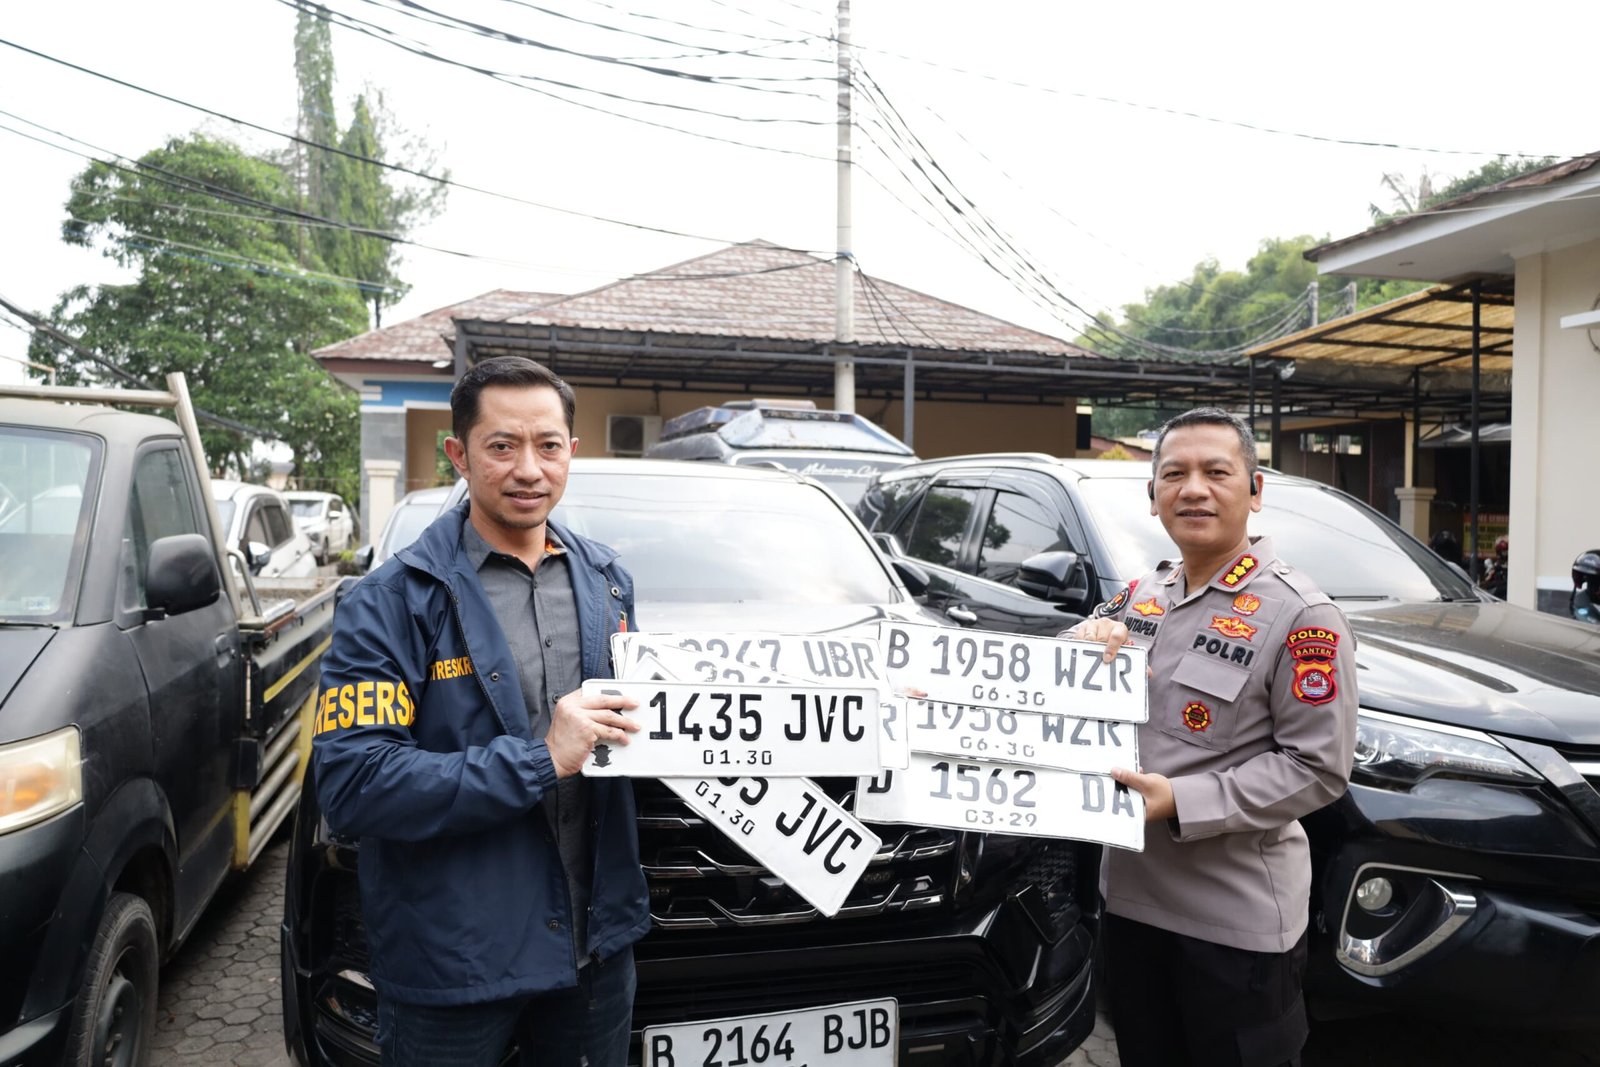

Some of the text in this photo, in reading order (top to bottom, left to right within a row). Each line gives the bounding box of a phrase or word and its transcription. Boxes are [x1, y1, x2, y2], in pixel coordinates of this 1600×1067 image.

[1193, 634, 1254, 666] POLRI
[1289, 629, 1335, 644] POLDA
[1295, 647, 1332, 656] BANTEN
[803, 640, 879, 680] UBR
[886, 628, 1133, 693] B 1958 WZR
[972, 684, 1046, 706] 06.30
[649, 691, 762, 741] 1435
[784, 693, 865, 743] JVC
[703, 750, 772, 765] 01.30
[960, 736, 1035, 757] 06.30
[929, 761, 1037, 808] 1562
[1080, 773, 1135, 817] DA
[695, 780, 755, 836] 01.30
[965, 809, 1037, 827] 03.29
[775, 791, 863, 875] JVC
[652, 1008, 890, 1067] B 2164 BJB
